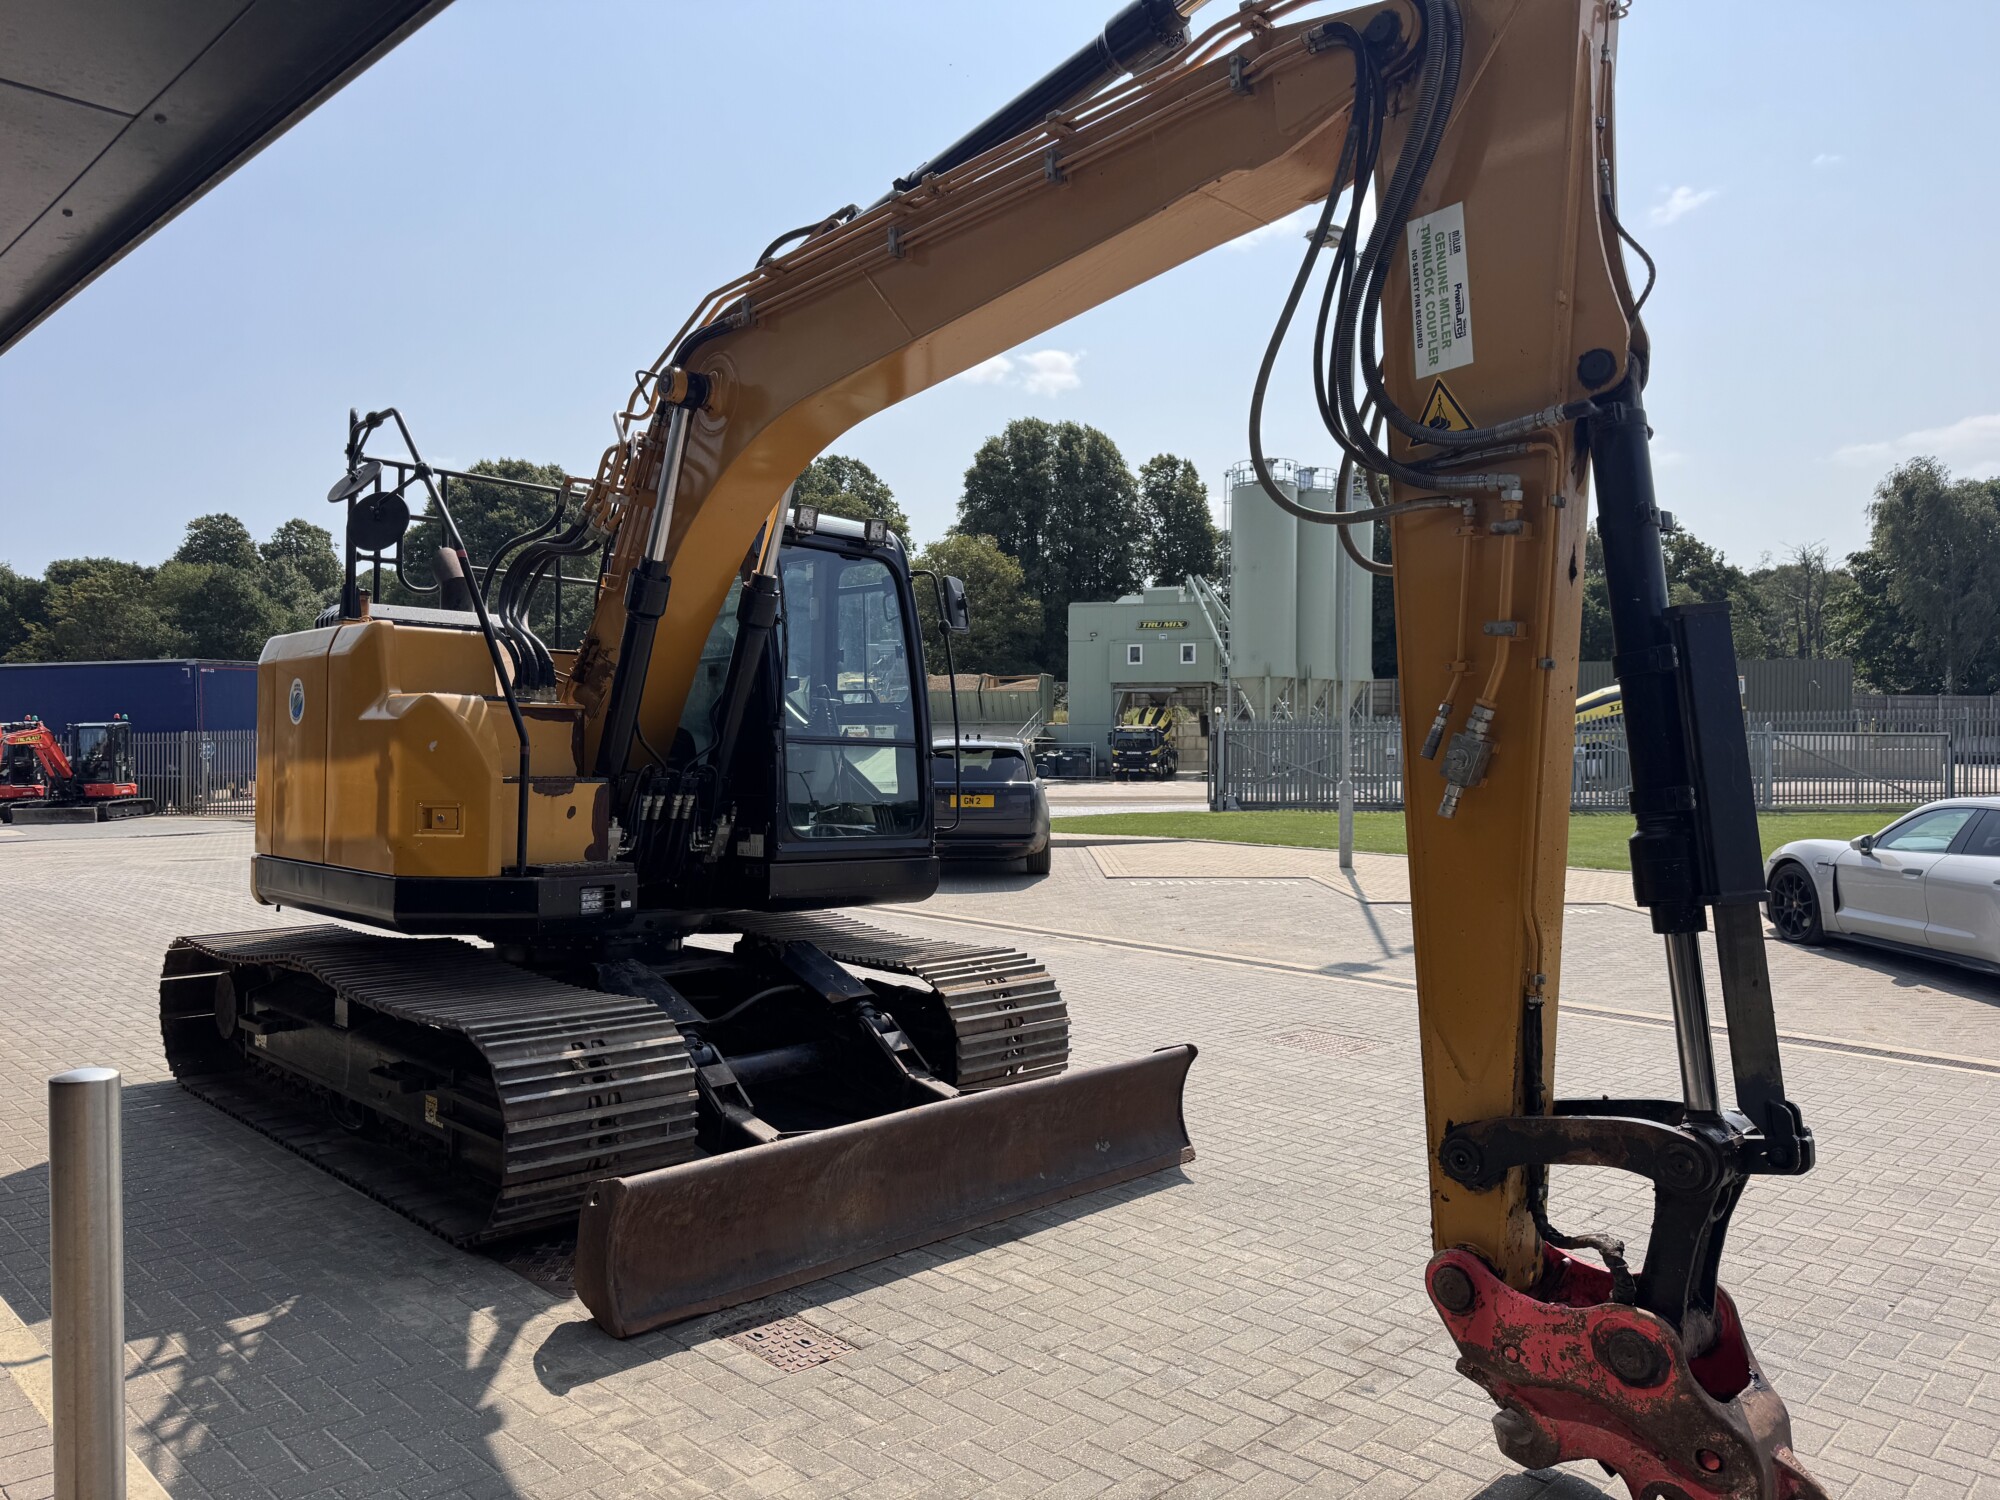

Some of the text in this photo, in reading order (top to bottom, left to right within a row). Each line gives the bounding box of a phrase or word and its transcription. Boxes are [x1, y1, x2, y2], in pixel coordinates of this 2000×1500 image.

[1412, 249, 1418, 261] NO
[1421, 224, 1439, 366] TWINLOCK COUPLER
[1435, 231, 1452, 350] GENUINE MILLER
[964, 797, 974, 805] GN
